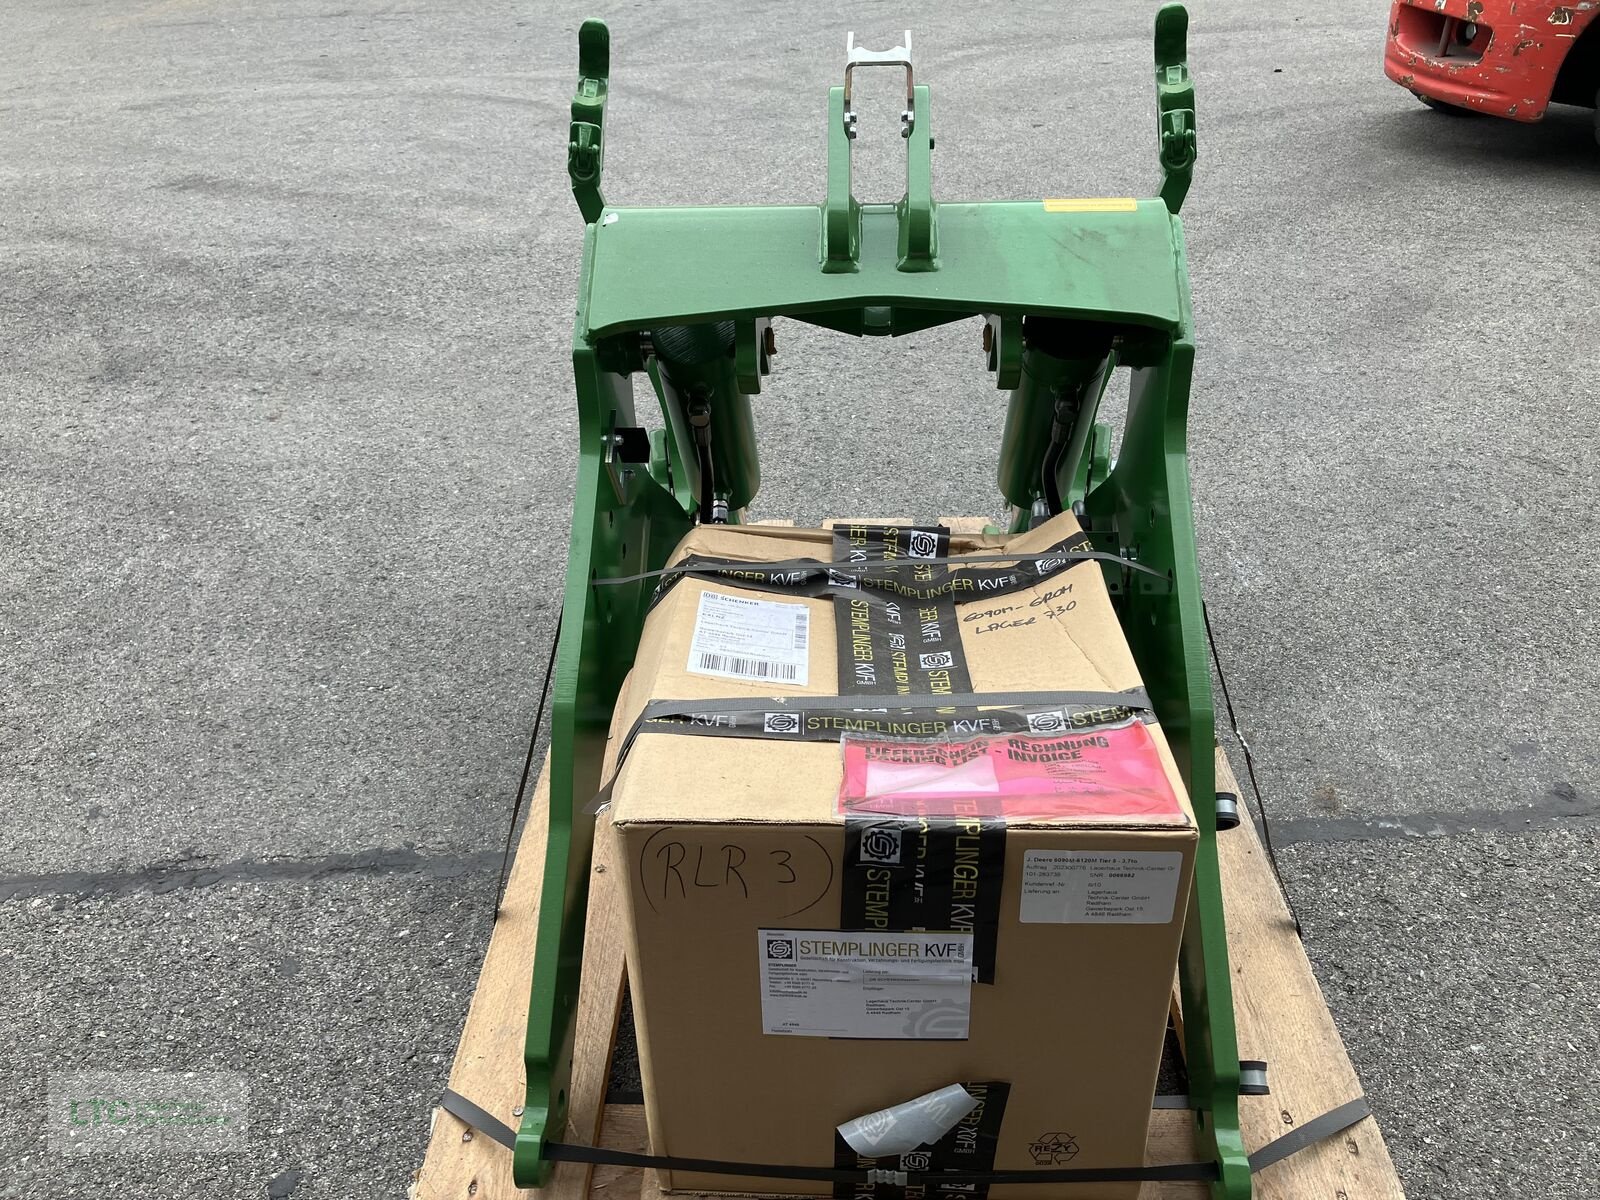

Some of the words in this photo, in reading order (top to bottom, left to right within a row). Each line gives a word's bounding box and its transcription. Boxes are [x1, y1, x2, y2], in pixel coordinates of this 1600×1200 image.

[769, 572, 801, 586] KVF
[864, 577, 973, 599] STEMPLINGER
[978, 576, 1009, 591] KVF
[851, 600, 873, 661] STEMPLINGER
[921, 622, 941, 637] KVF
[975, 617, 1037, 634] LAGER
[855, 663, 876, 681] KVF
[690, 713, 728, 727] KVF
[808, 717, 947, 734] STEMPLINGER
[953, 719, 991, 733] KVF
[865, 741, 989, 758] LIEFERSCHEIN
[1008, 736, 1109, 753] RECHNUNG
[953, 747, 989, 766] LIST
[1008, 749, 1083, 763] INVOICE
[799, 940, 919, 957] STEMPLINGER
[925, 943, 957, 957] KVF
